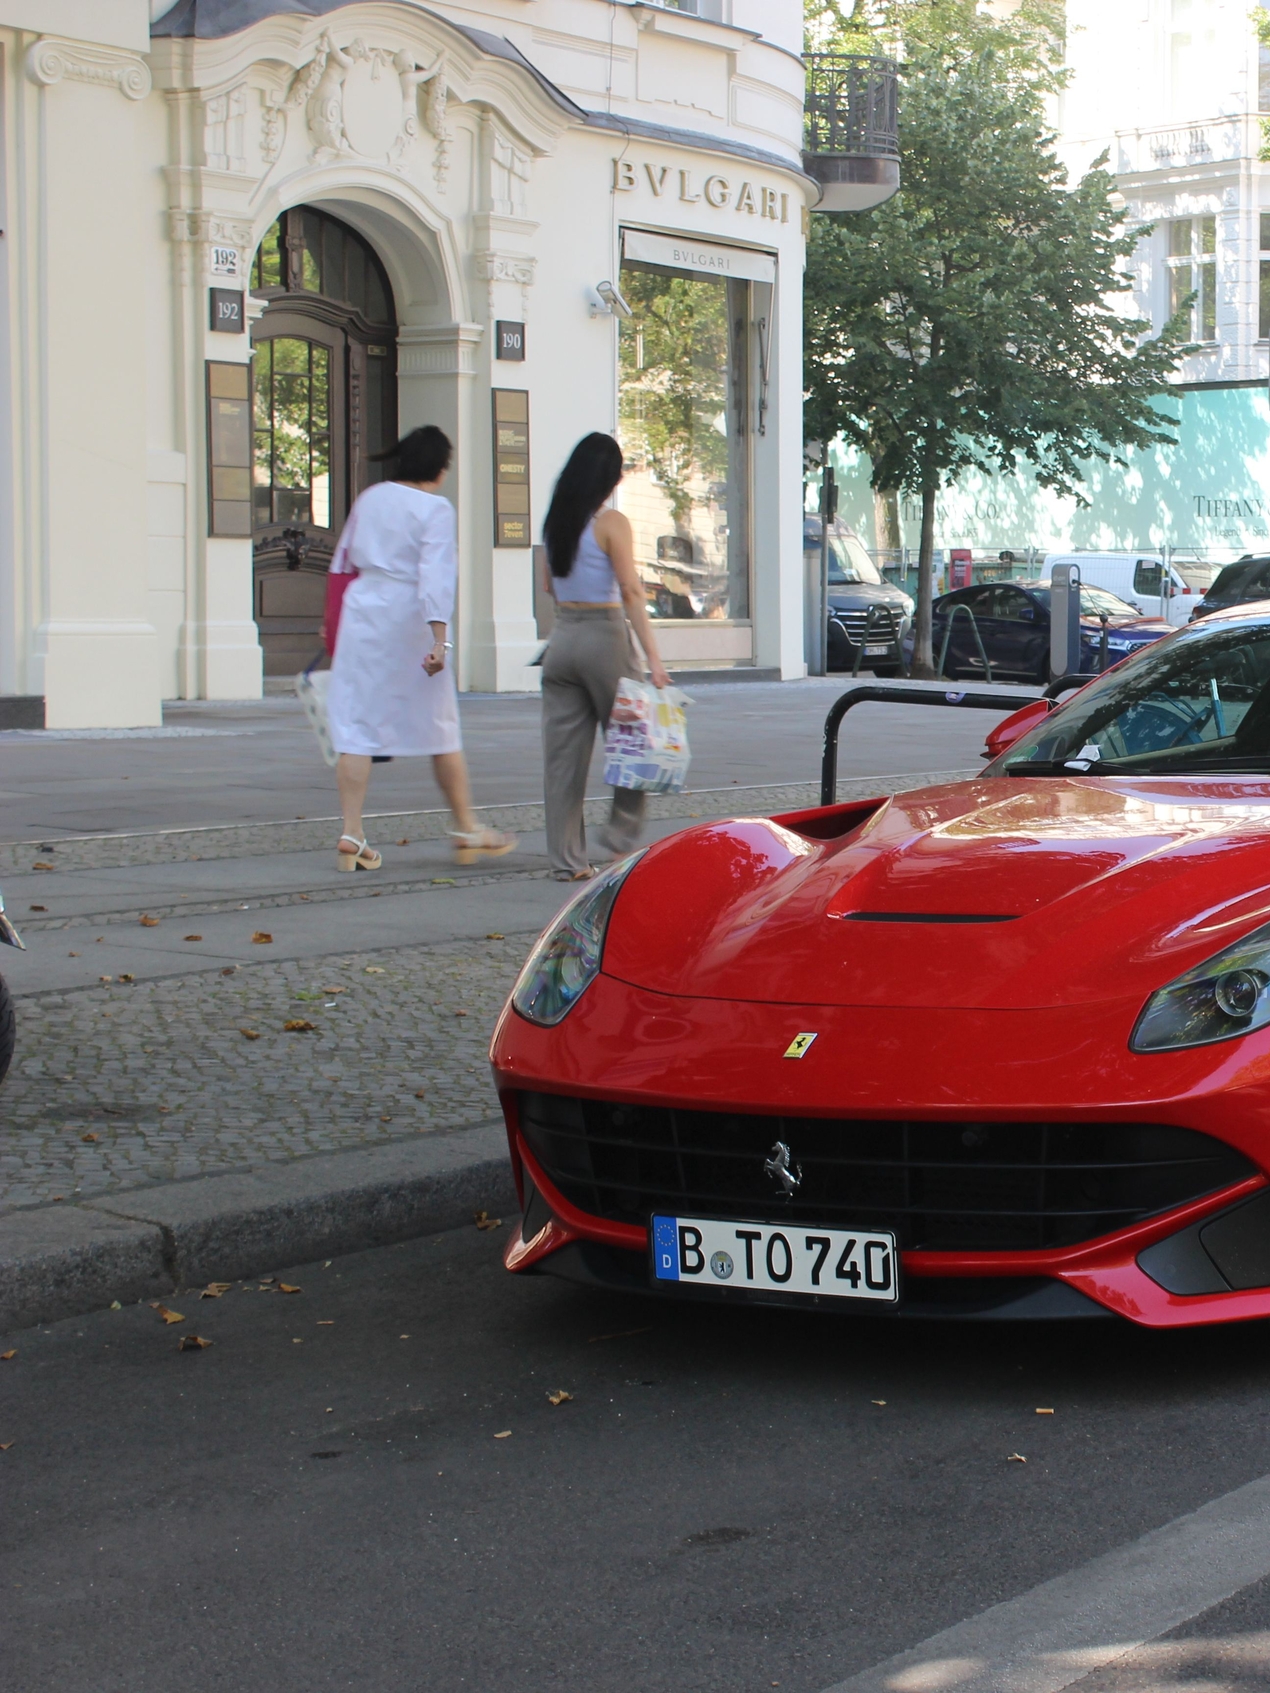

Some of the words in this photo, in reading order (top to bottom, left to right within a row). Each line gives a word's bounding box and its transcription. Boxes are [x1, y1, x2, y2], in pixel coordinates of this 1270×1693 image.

[612, 157, 790, 224] BVLGARI
[213, 249, 237, 267] 192
[673, 249, 730, 270] BVLGARI
[218, 302, 239, 320] 192
[503, 333, 521, 349] 190
[1193, 495, 1265, 518] TIFFANY
[662, 1253, 673, 1269] D
[678, 1225, 706, 1275] B
[735, 1229, 793, 1284] TO
[805, 1235, 892, 1291] 740
